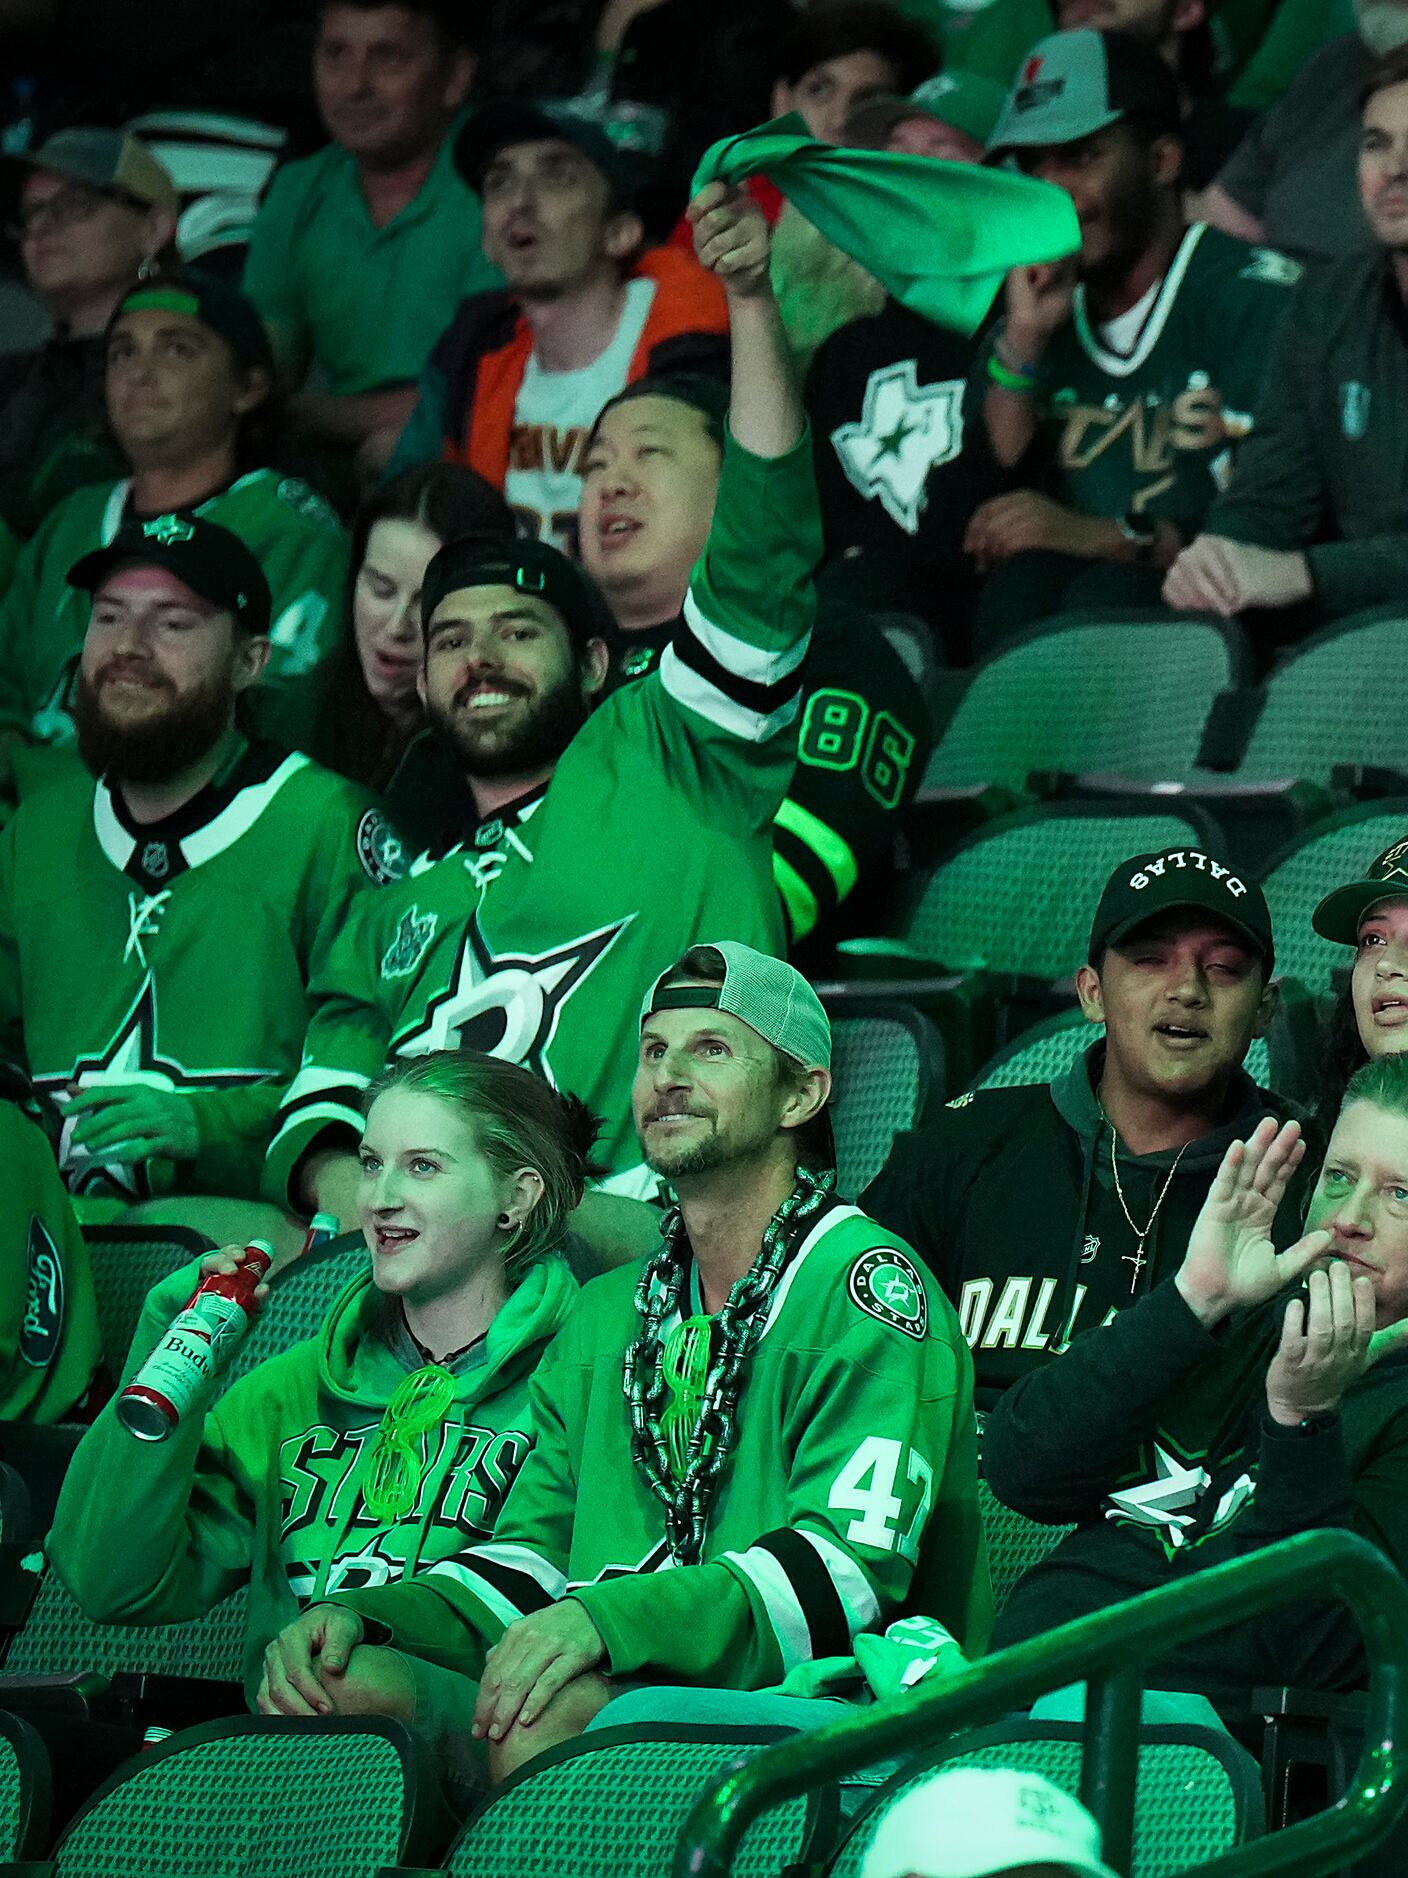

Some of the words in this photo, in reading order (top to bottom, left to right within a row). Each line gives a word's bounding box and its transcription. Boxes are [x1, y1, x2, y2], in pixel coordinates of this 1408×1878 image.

[797, 687, 915, 809] 86
[1129, 851, 1247, 898] DALLAS
[24, 1253, 58, 1338] Ford
[856, 1254, 924, 1295] DALLAS
[871, 1302, 926, 1332] STARS
[958, 1276, 1119, 1356] DALL
